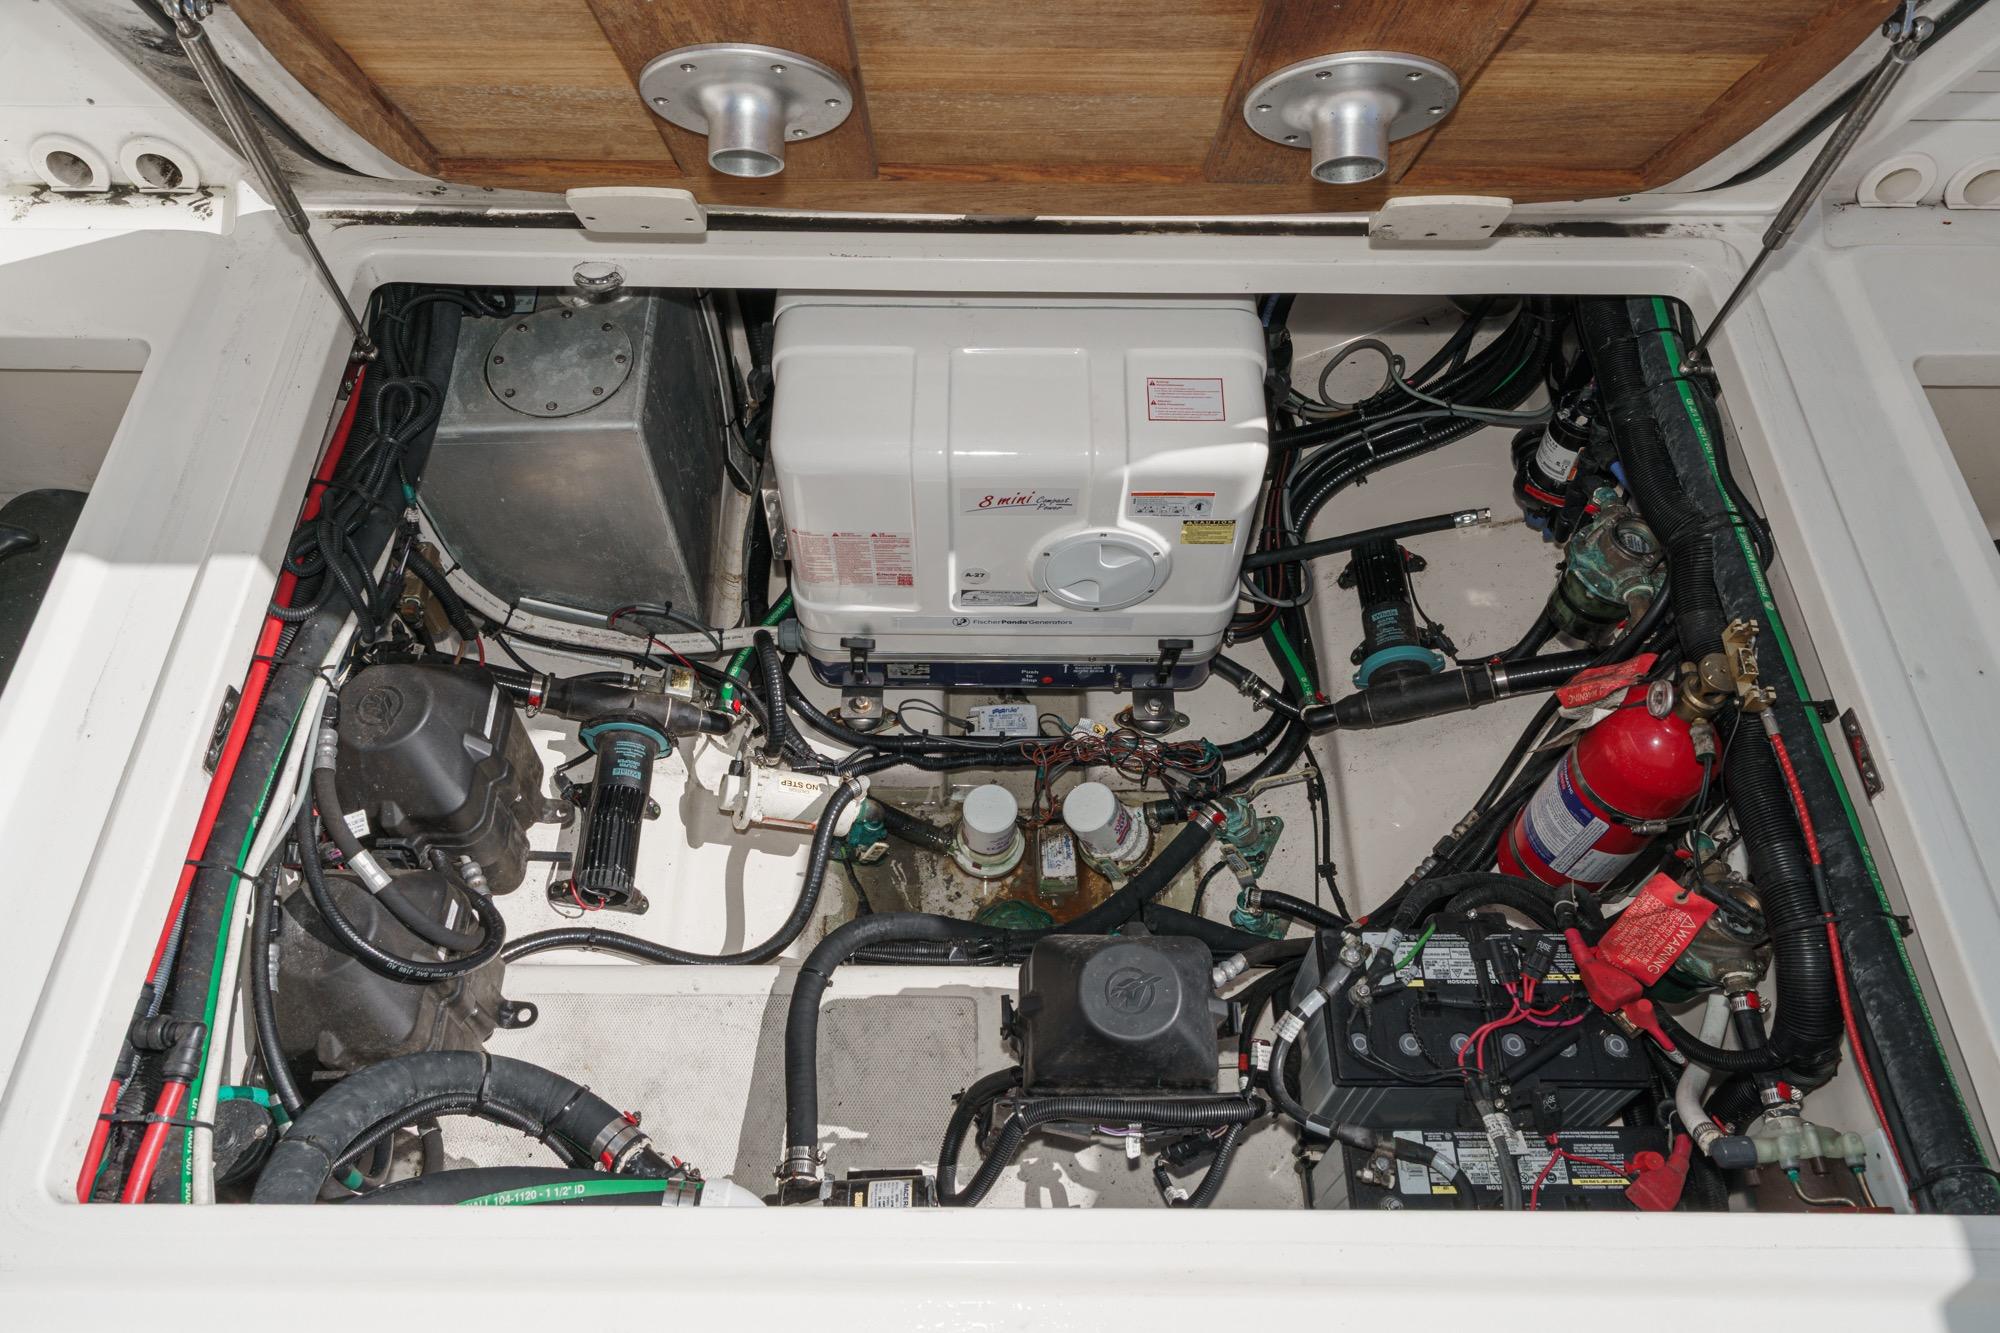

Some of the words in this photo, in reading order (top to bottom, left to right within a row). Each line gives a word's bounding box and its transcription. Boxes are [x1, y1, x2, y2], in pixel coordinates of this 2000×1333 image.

[979, 495, 994, 508] 8
[997, 491, 1036, 506] mini
[1037, 503, 1062, 511] Power
[780, 778, 804, 788] STEP
[804, 782, 819, 790] NO
[1656, 907, 1680, 934] REMOVED
[1661, 920, 1679, 940] SAFETY
[1647, 928, 1691, 974] WARNING
[415, 969, 429, 978] SAE
[492, 1189, 538, 1206] 104-1120
[553, 1184, 572, 1198] 1/2"
[572, 1183, 586, 1195] ID
